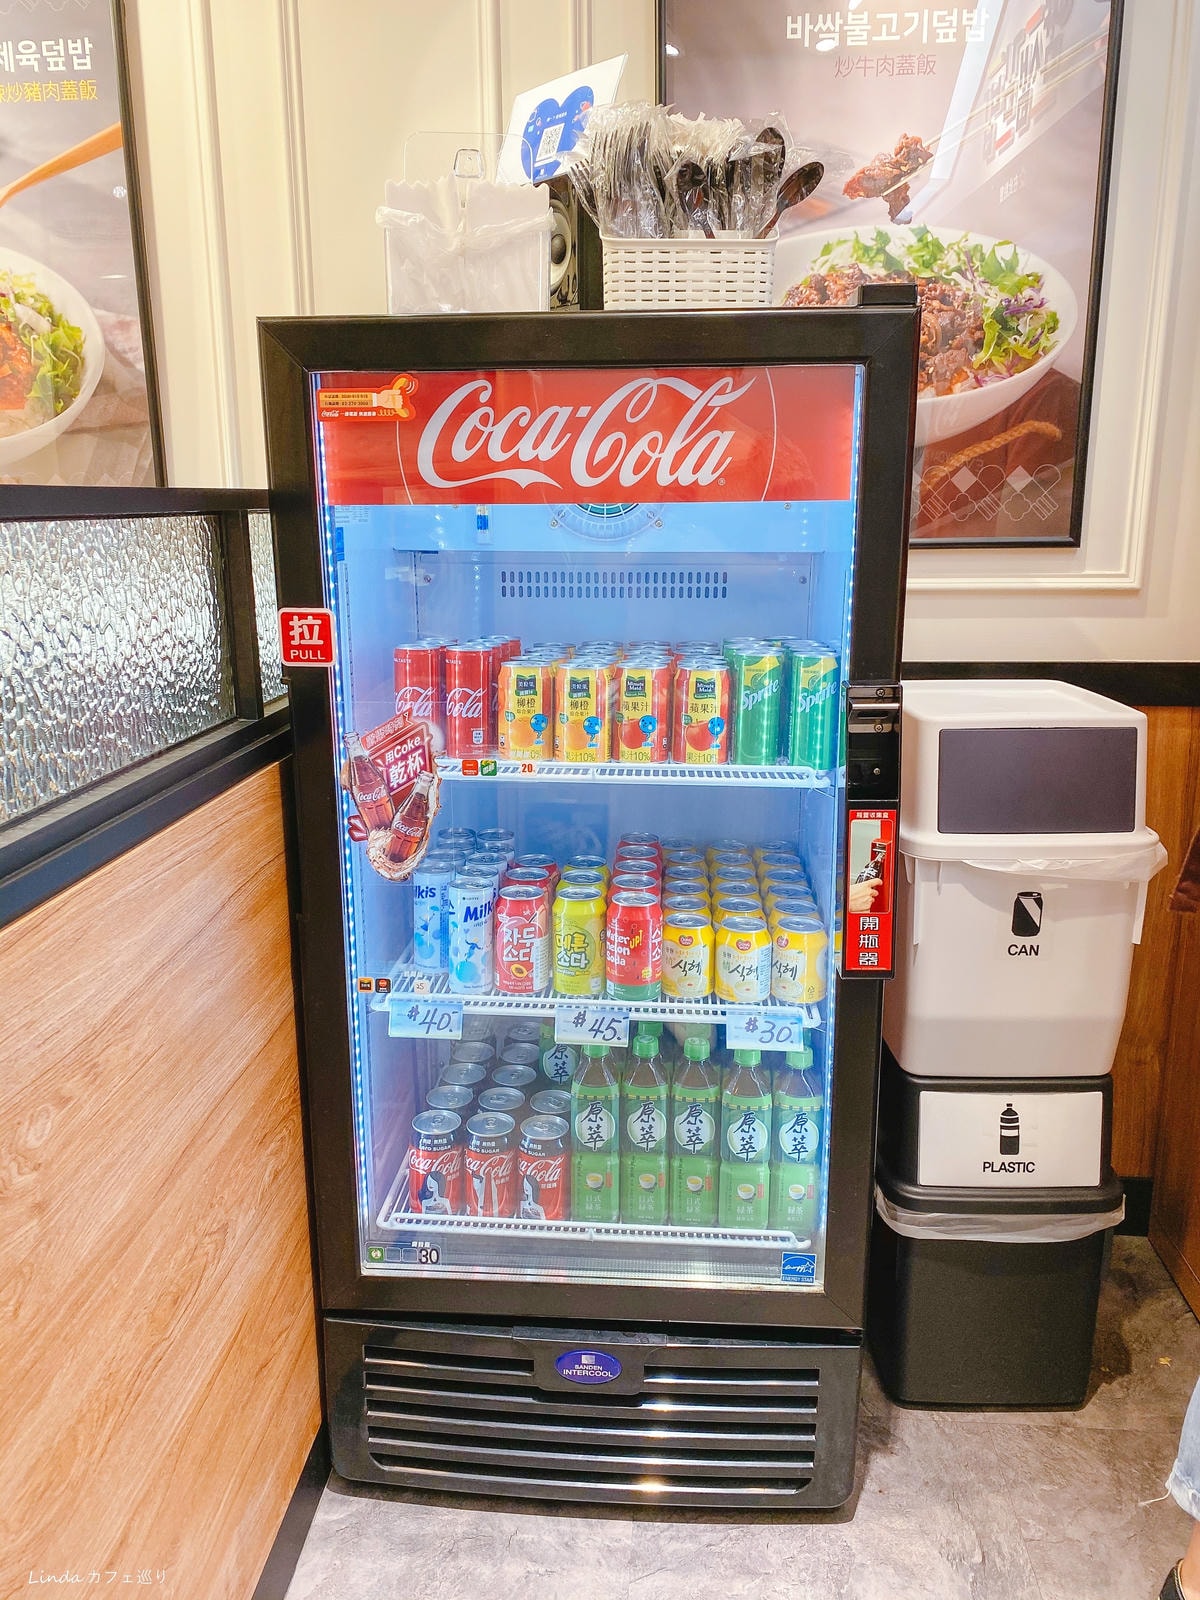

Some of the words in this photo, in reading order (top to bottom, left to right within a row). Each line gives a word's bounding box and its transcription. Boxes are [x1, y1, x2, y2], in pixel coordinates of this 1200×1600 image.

[834, 54, 937, 79] 炒牛肉蓋飯
[417, 376, 758, 489] Coca-Cola
[289, 615, 324, 646] 拉
[290, 649, 326, 660] PULL
[517, 698, 536, 708] 柳橙
[570, 700, 589, 711] 柳橙
[742, 679, 780, 711] Sprite
[797, 681, 838, 713] Sprite
[385, 736, 421, 762] 用Coke
[390, 749, 424, 789] 乾杯
[521, 763, 533, 773] 20
[859, 916, 879, 966] 開瓶器
[1007, 943, 1040, 957] CAN
[557, 948, 590, 969] 소다
[580, 1100, 605, 1152] 原萃
[633, 1100, 658, 1152] 原萃
[679, 1103, 704, 1154] 原萃
[733, 1112, 758, 1162] 原萃
[784, 1112, 809, 1162] 原萃
[982, 1161, 1036, 1173] PLASTIC
[419, 1248, 439, 1264] 30
[563, 1369, 614, 1378] INTERCOOL
